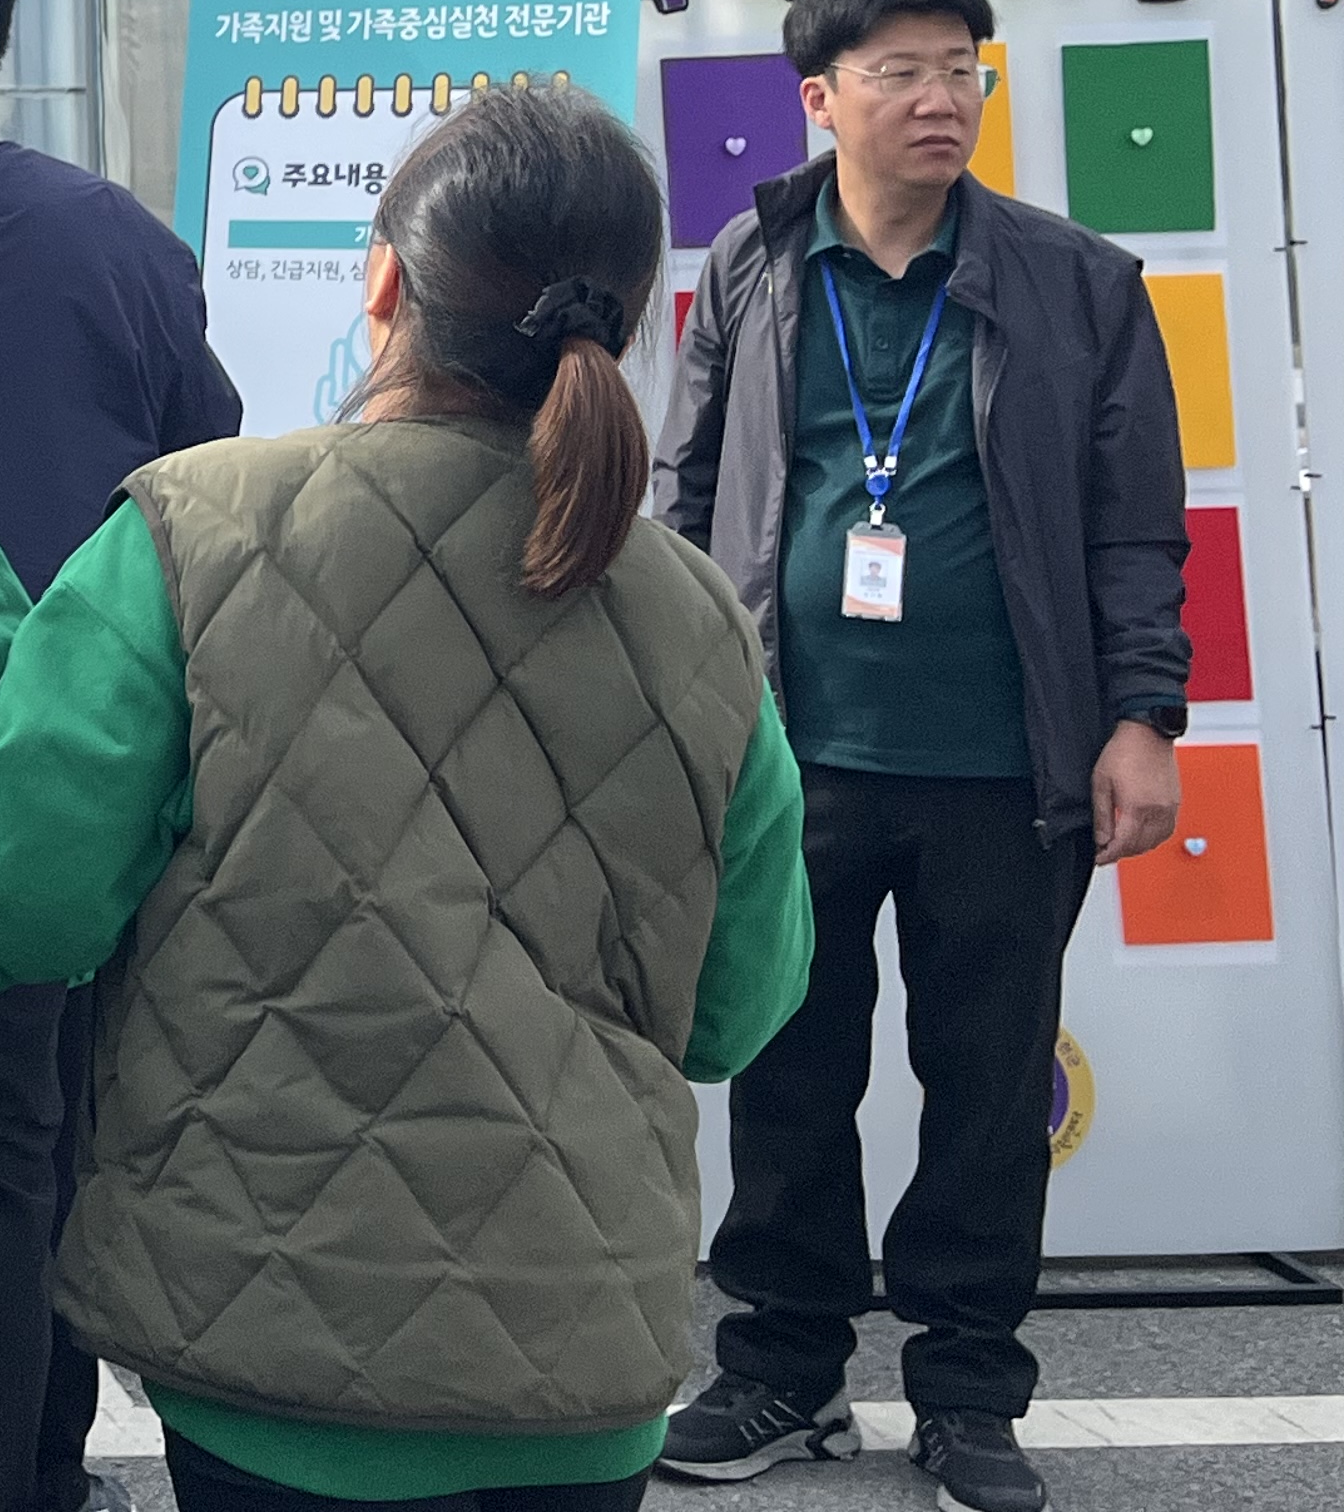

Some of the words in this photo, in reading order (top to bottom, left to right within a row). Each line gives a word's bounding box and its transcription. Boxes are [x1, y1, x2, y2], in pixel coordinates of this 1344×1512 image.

[215, 9, 312, 44] 가족지원
[318, 8, 342, 42] 및
[346, 3, 499, 41] 가족중심실천
[504, 0, 612, 37] 전문기관
[282, 161, 388, 196] 주요내용
[227, 259, 266, 282] 상담,
[271, 260, 345, 284] 긴급지원,
